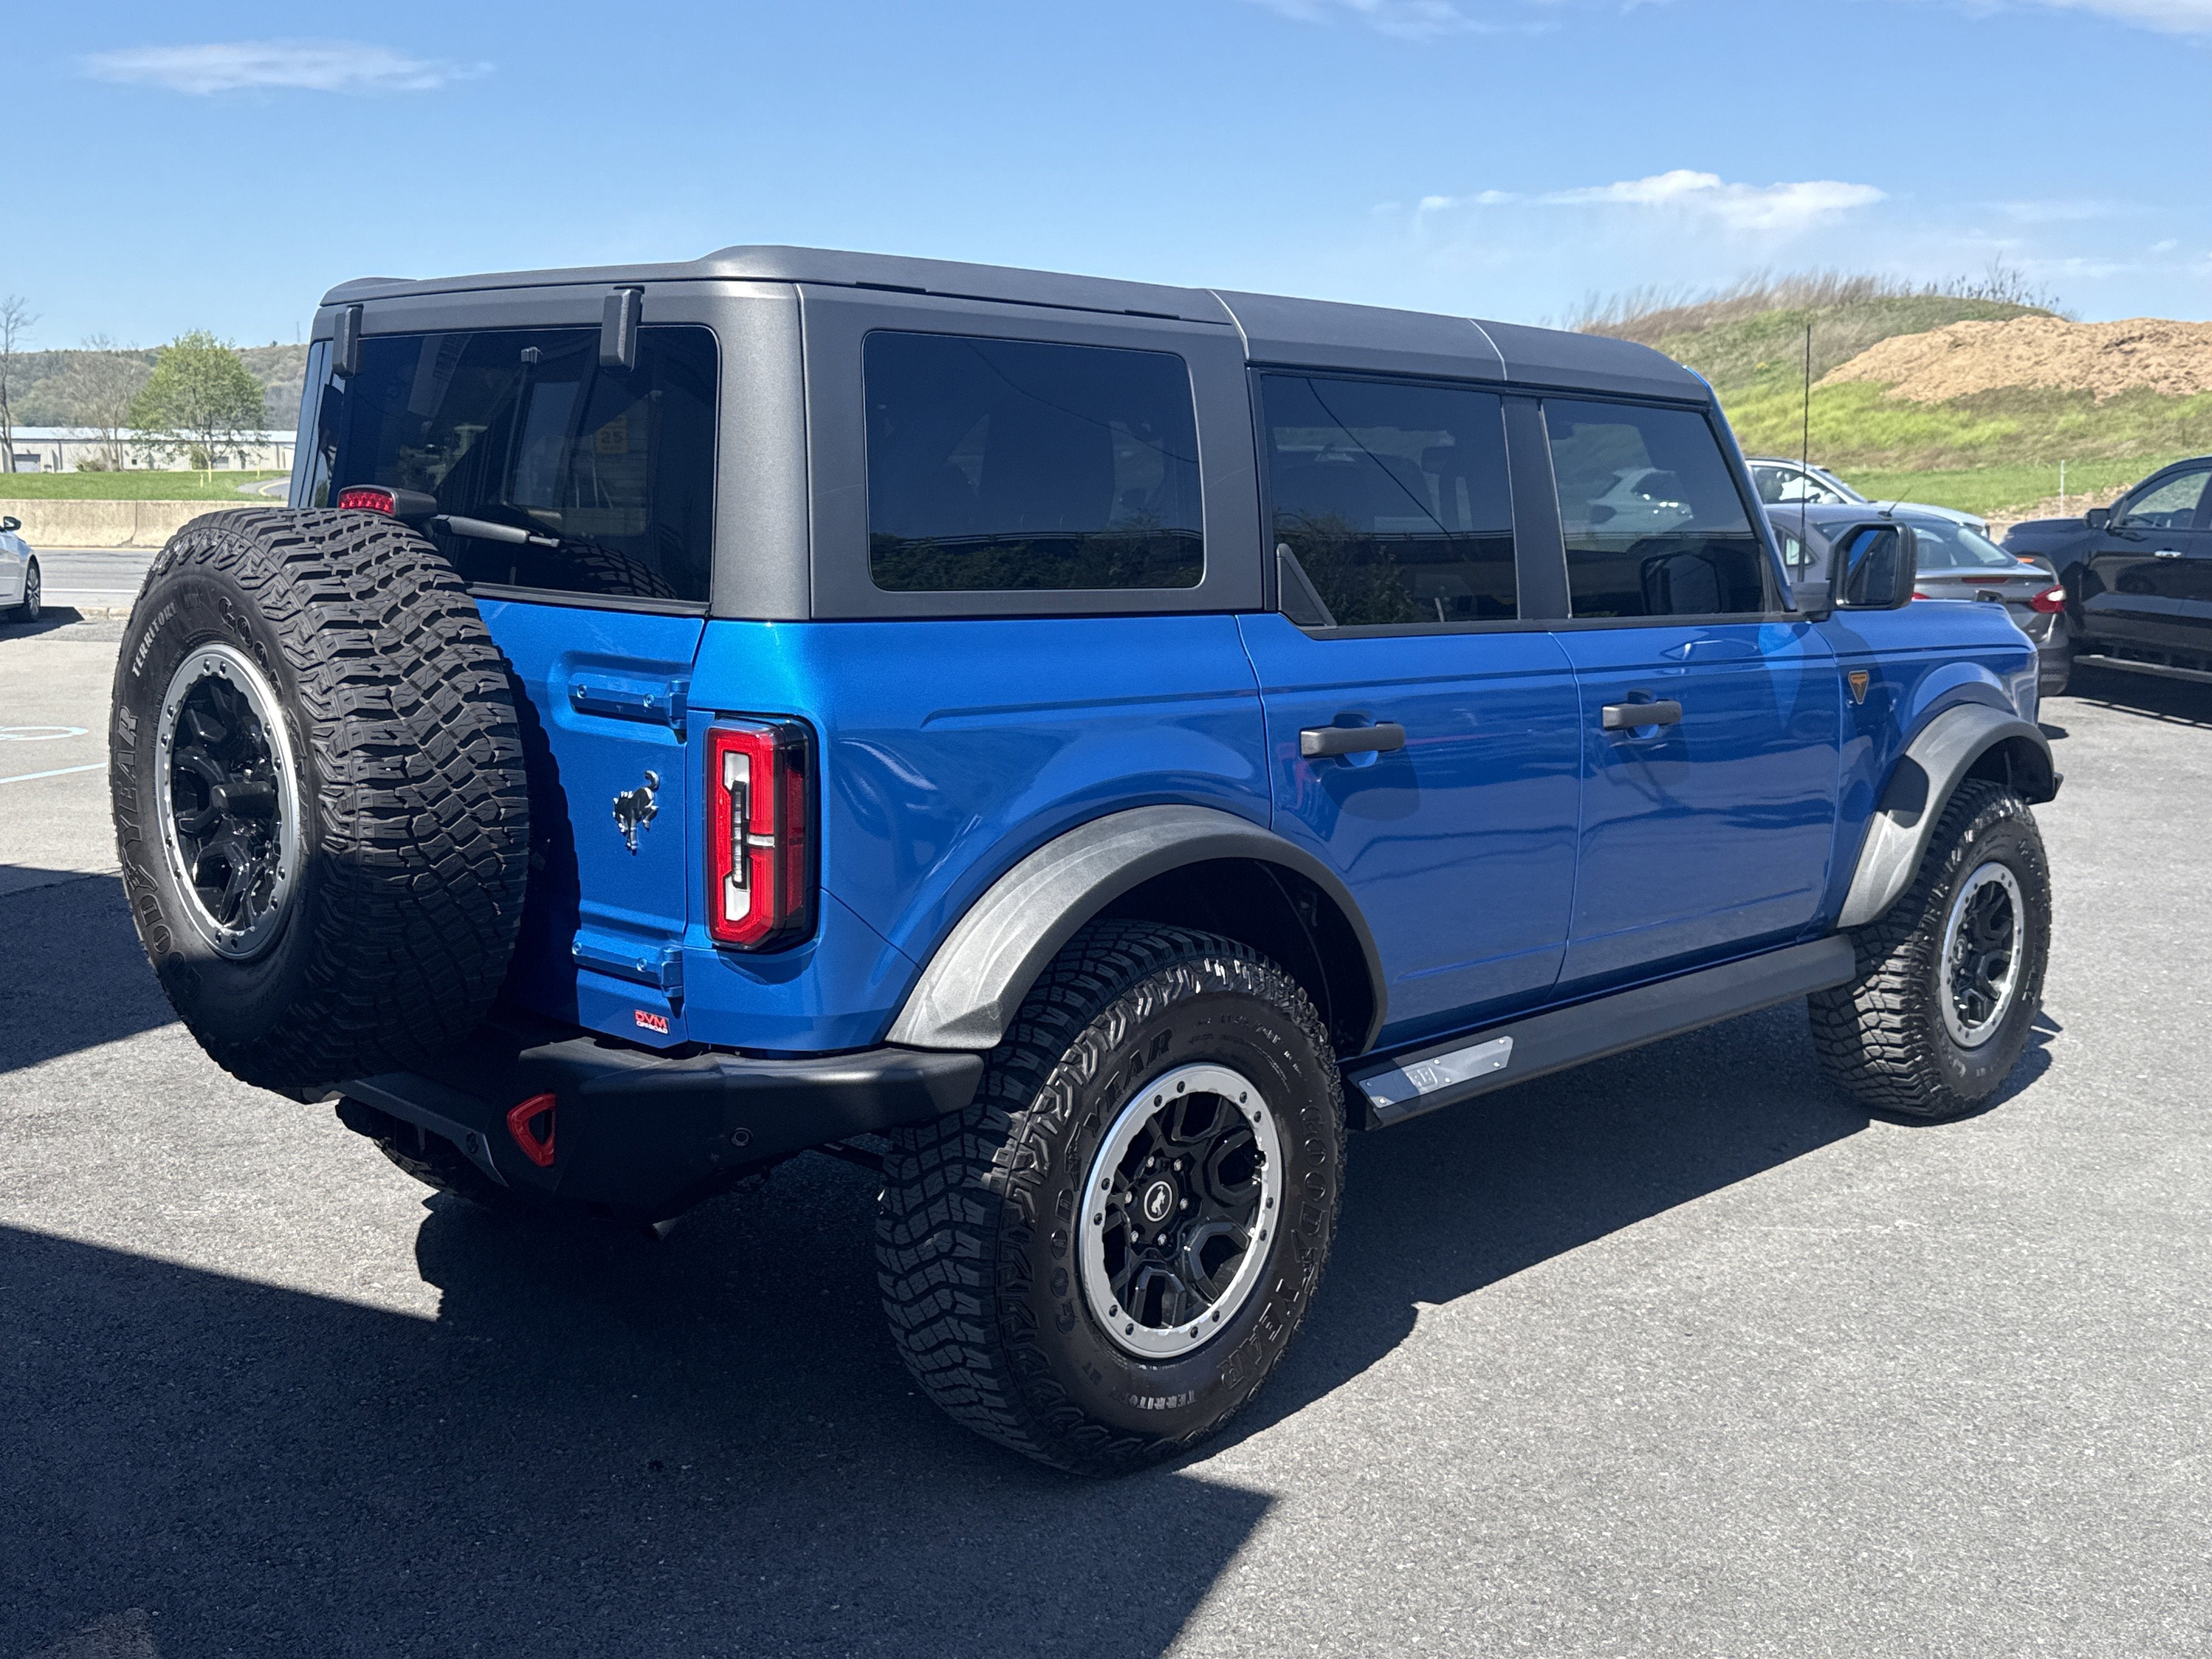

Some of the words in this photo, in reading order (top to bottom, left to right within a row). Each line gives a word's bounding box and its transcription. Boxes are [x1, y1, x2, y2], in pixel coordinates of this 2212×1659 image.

[132, 601, 177, 678] TERRITORY
[116, 705, 202, 1000] GOODYEAR
[635, 1011, 668, 1029] DVM
[1051, 1028, 1173, 1334] GOODYEAR
[1216, 1106, 1325, 1390] GOODYEAR
